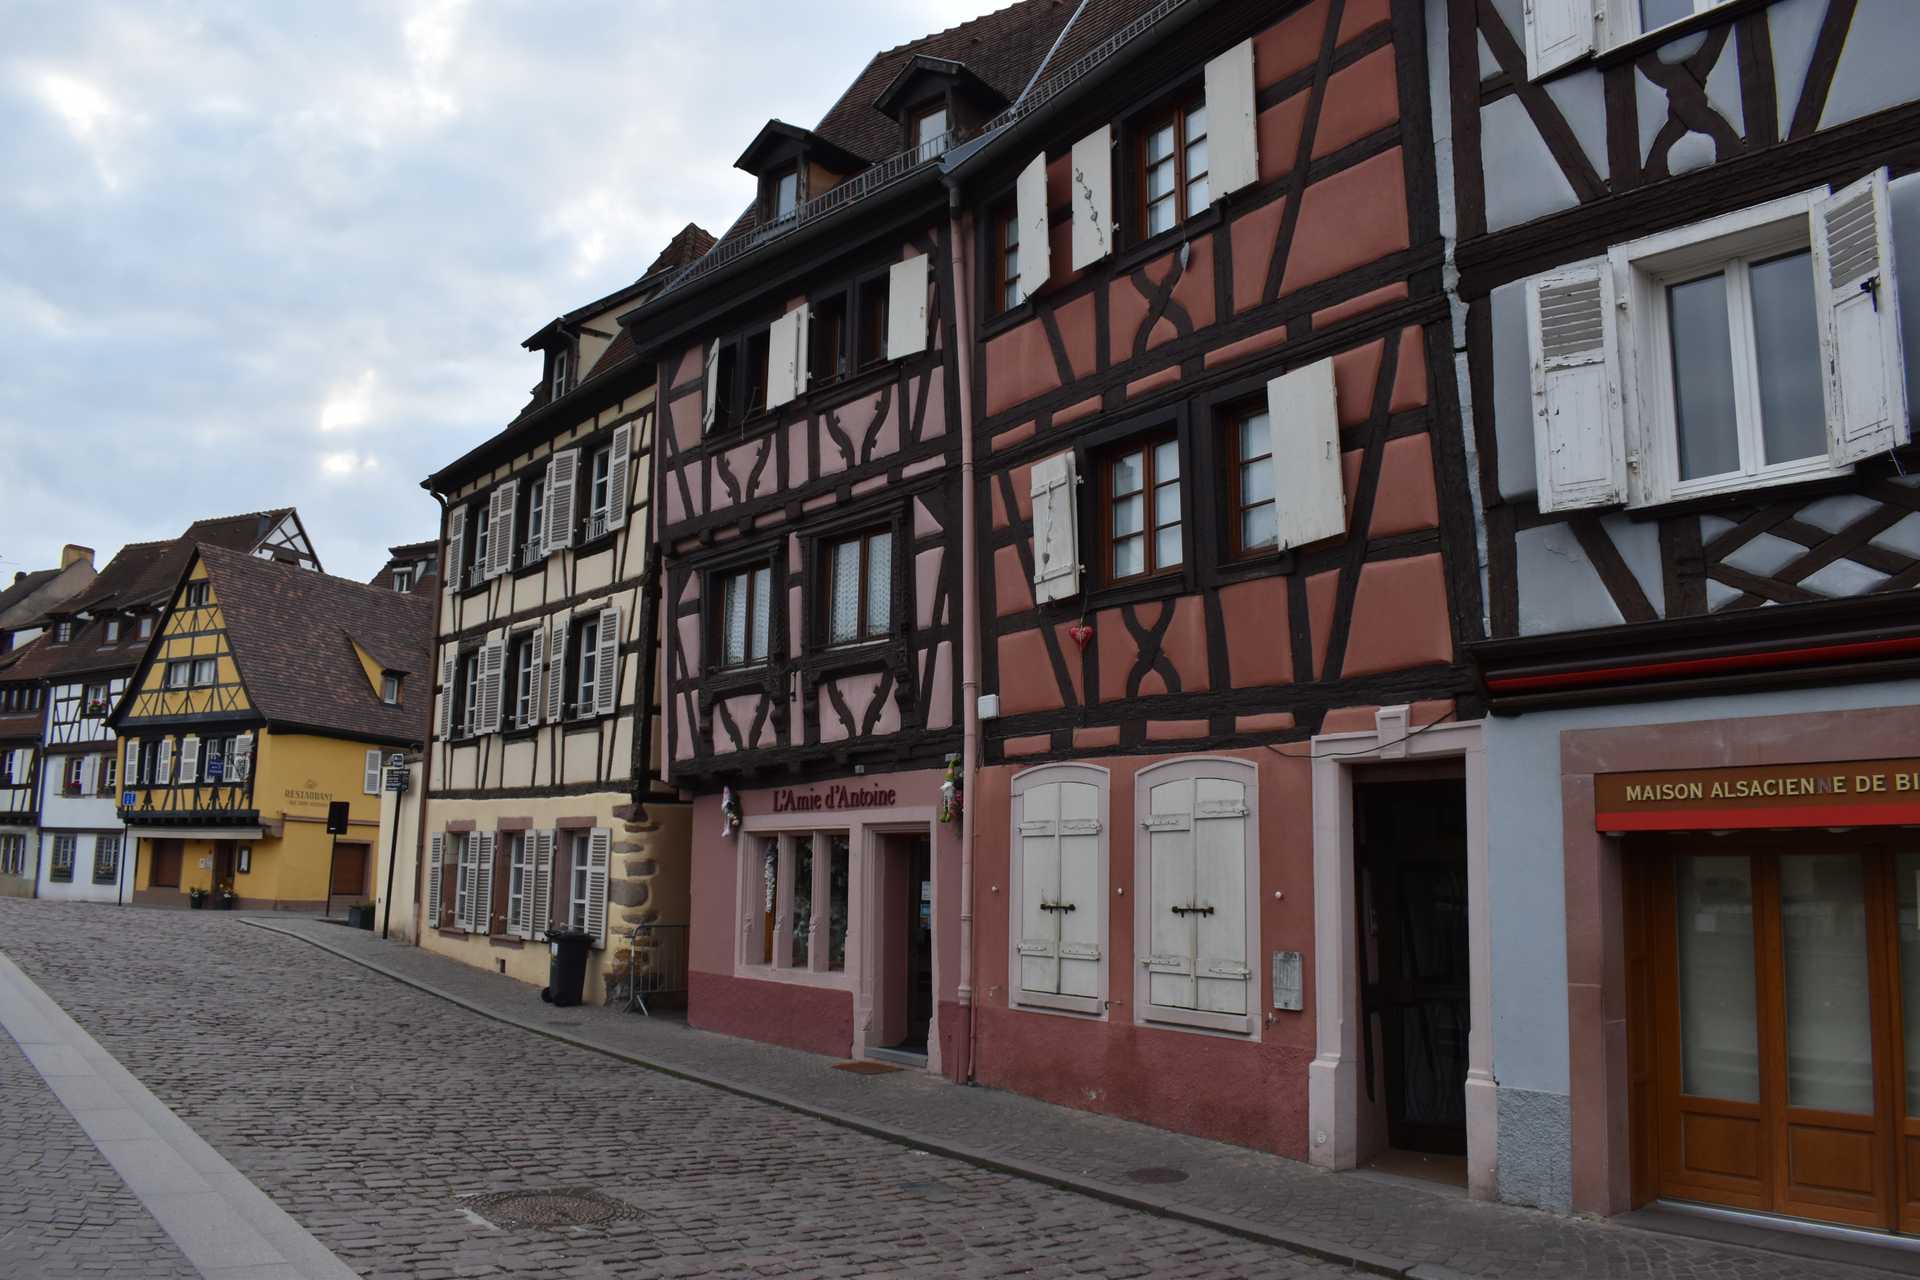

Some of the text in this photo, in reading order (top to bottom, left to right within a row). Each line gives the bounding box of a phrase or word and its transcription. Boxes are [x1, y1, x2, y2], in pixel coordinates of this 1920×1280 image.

[773, 782, 896, 812] L'Amie d'Antoine
[1626, 783, 1703, 801] MAISON
[1710, 776, 1847, 798] ALSACIENNE
[1855, 774, 1887, 793] DE
